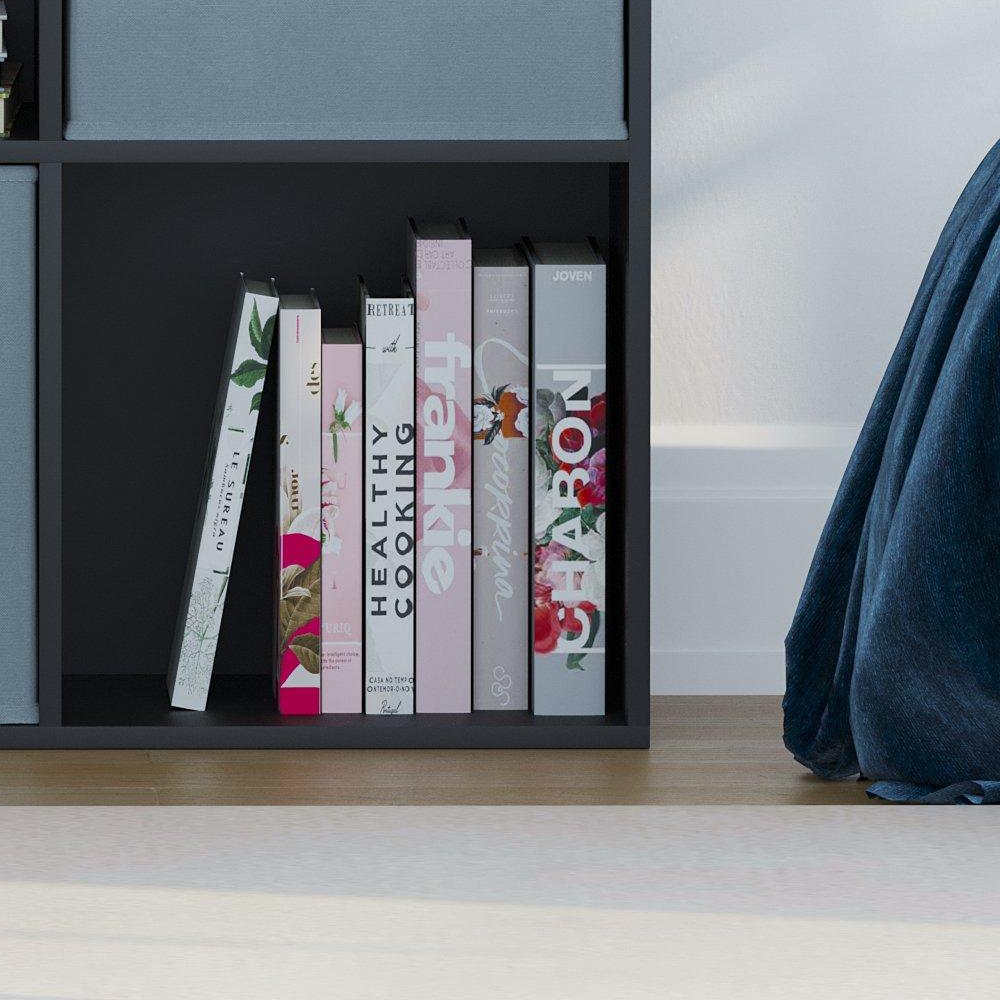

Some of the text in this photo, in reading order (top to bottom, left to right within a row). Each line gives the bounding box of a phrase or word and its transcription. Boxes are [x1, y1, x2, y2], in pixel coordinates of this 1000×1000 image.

[367, 303, 414, 317] RETREAT
[552, 271, 593, 282] JOVEN
[216, 451, 240, 552] LE SUREAU
[371, 424, 388, 616] HEALTHY
[395, 423, 414, 619] COOKING
[422, 332, 471, 595] frankie
[551, 370, 593, 648] CHABON
